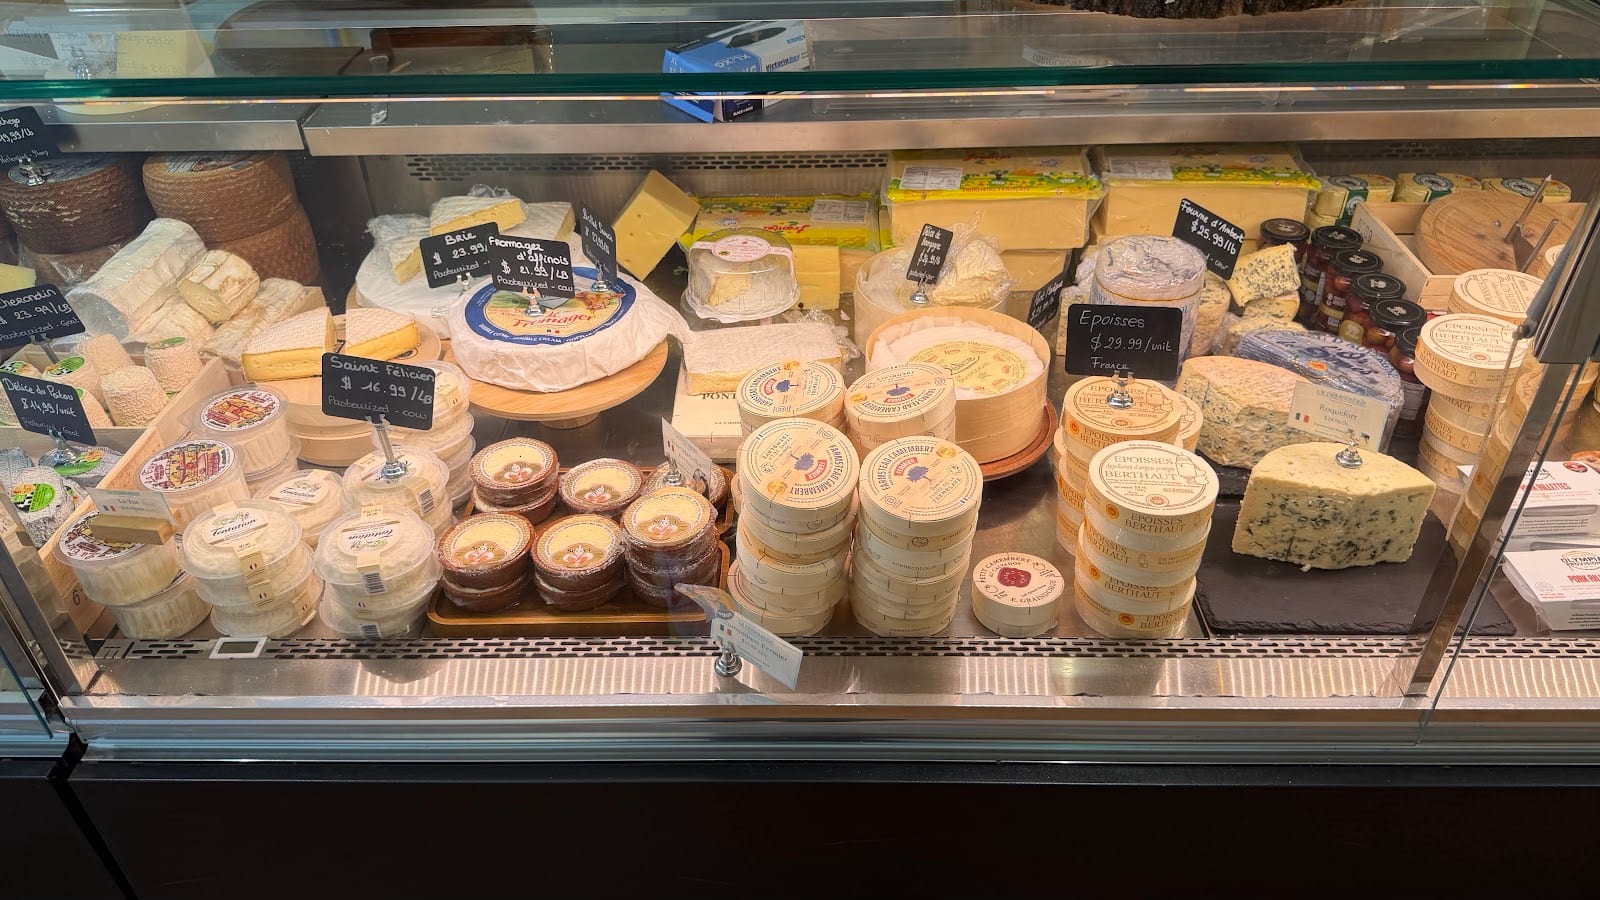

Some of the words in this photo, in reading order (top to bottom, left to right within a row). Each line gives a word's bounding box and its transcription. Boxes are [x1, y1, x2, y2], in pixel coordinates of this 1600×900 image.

[1181, 200, 1209, 223] Fourme
[1210, 219, 1245, 243] d'Ambert
[445, 232, 477, 246] Brie
[433, 252, 443, 266] $
[516, 251, 569, 267] d'affinois
[501, 259, 512, 275] $
[513, 314, 597, 329] Fromager
[1079, 309, 1146, 333] Epoisses
[330, 355, 380, 374] Saint
[385, 364, 435, 382] Félicien
[1091, 356, 1131, 370] France
[341, 375, 352, 390] $
[1320, 403, 1359, 421] Roquefort
[828, 444, 845, 481] FARMSTEAD
[1114, 455, 1174, 465] EPOISSES
[876, 457, 892, 491] FARMSTEAD
[888, 446, 935, 461] CAMEMBERT
[1104, 470, 1177, 481] BERTHAUT
[790, 478, 836, 496] CAMEMBERT
[1125, 519, 1185, 534] BERTHAUT
[1131, 513, 1184, 526] EPOISSES
[1104, 582, 1161, 599] BERTHAUT
[1108, 576, 1159, 590] EPOISSES
